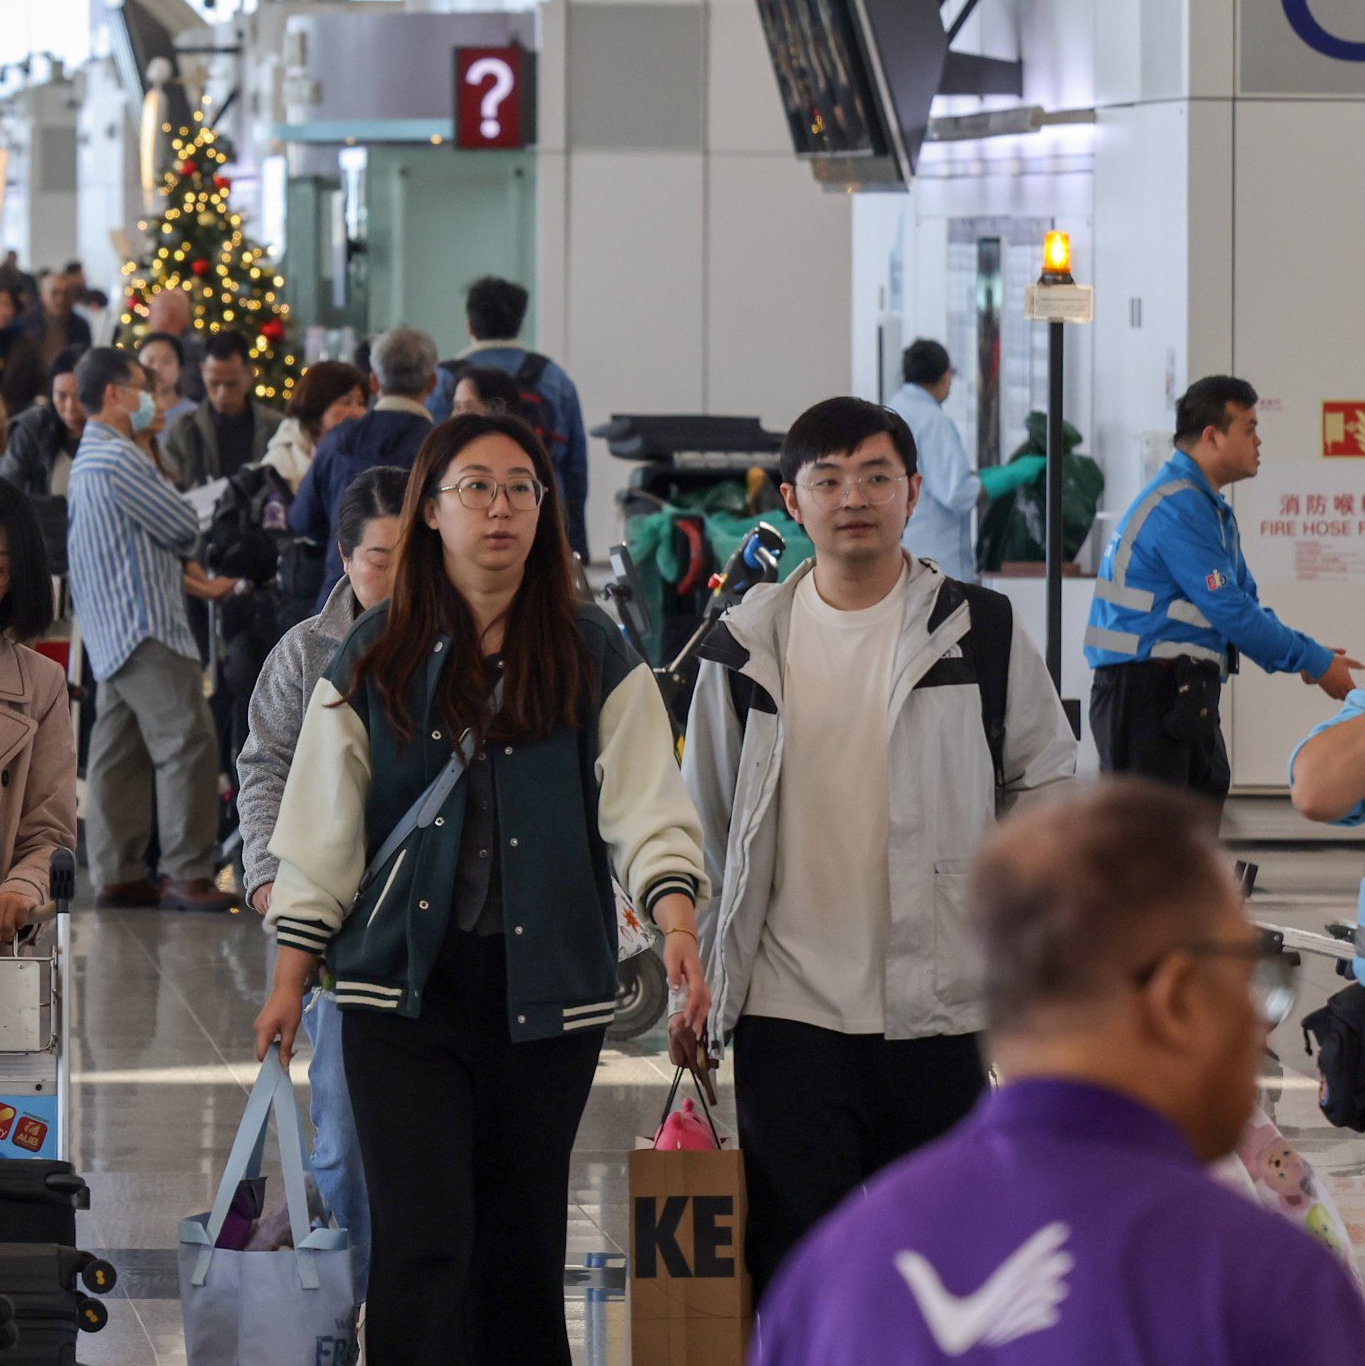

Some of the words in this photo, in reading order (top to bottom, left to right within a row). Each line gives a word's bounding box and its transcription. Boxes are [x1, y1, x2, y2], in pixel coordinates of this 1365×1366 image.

[1279, 494, 1365, 515] 消防喉
[1260, 521, 1296, 536] FIRE
[1302, 520, 1351, 536] HOSE
[17, 1133, 40, 1147] AUB
[634, 1195, 736, 1279] KE
